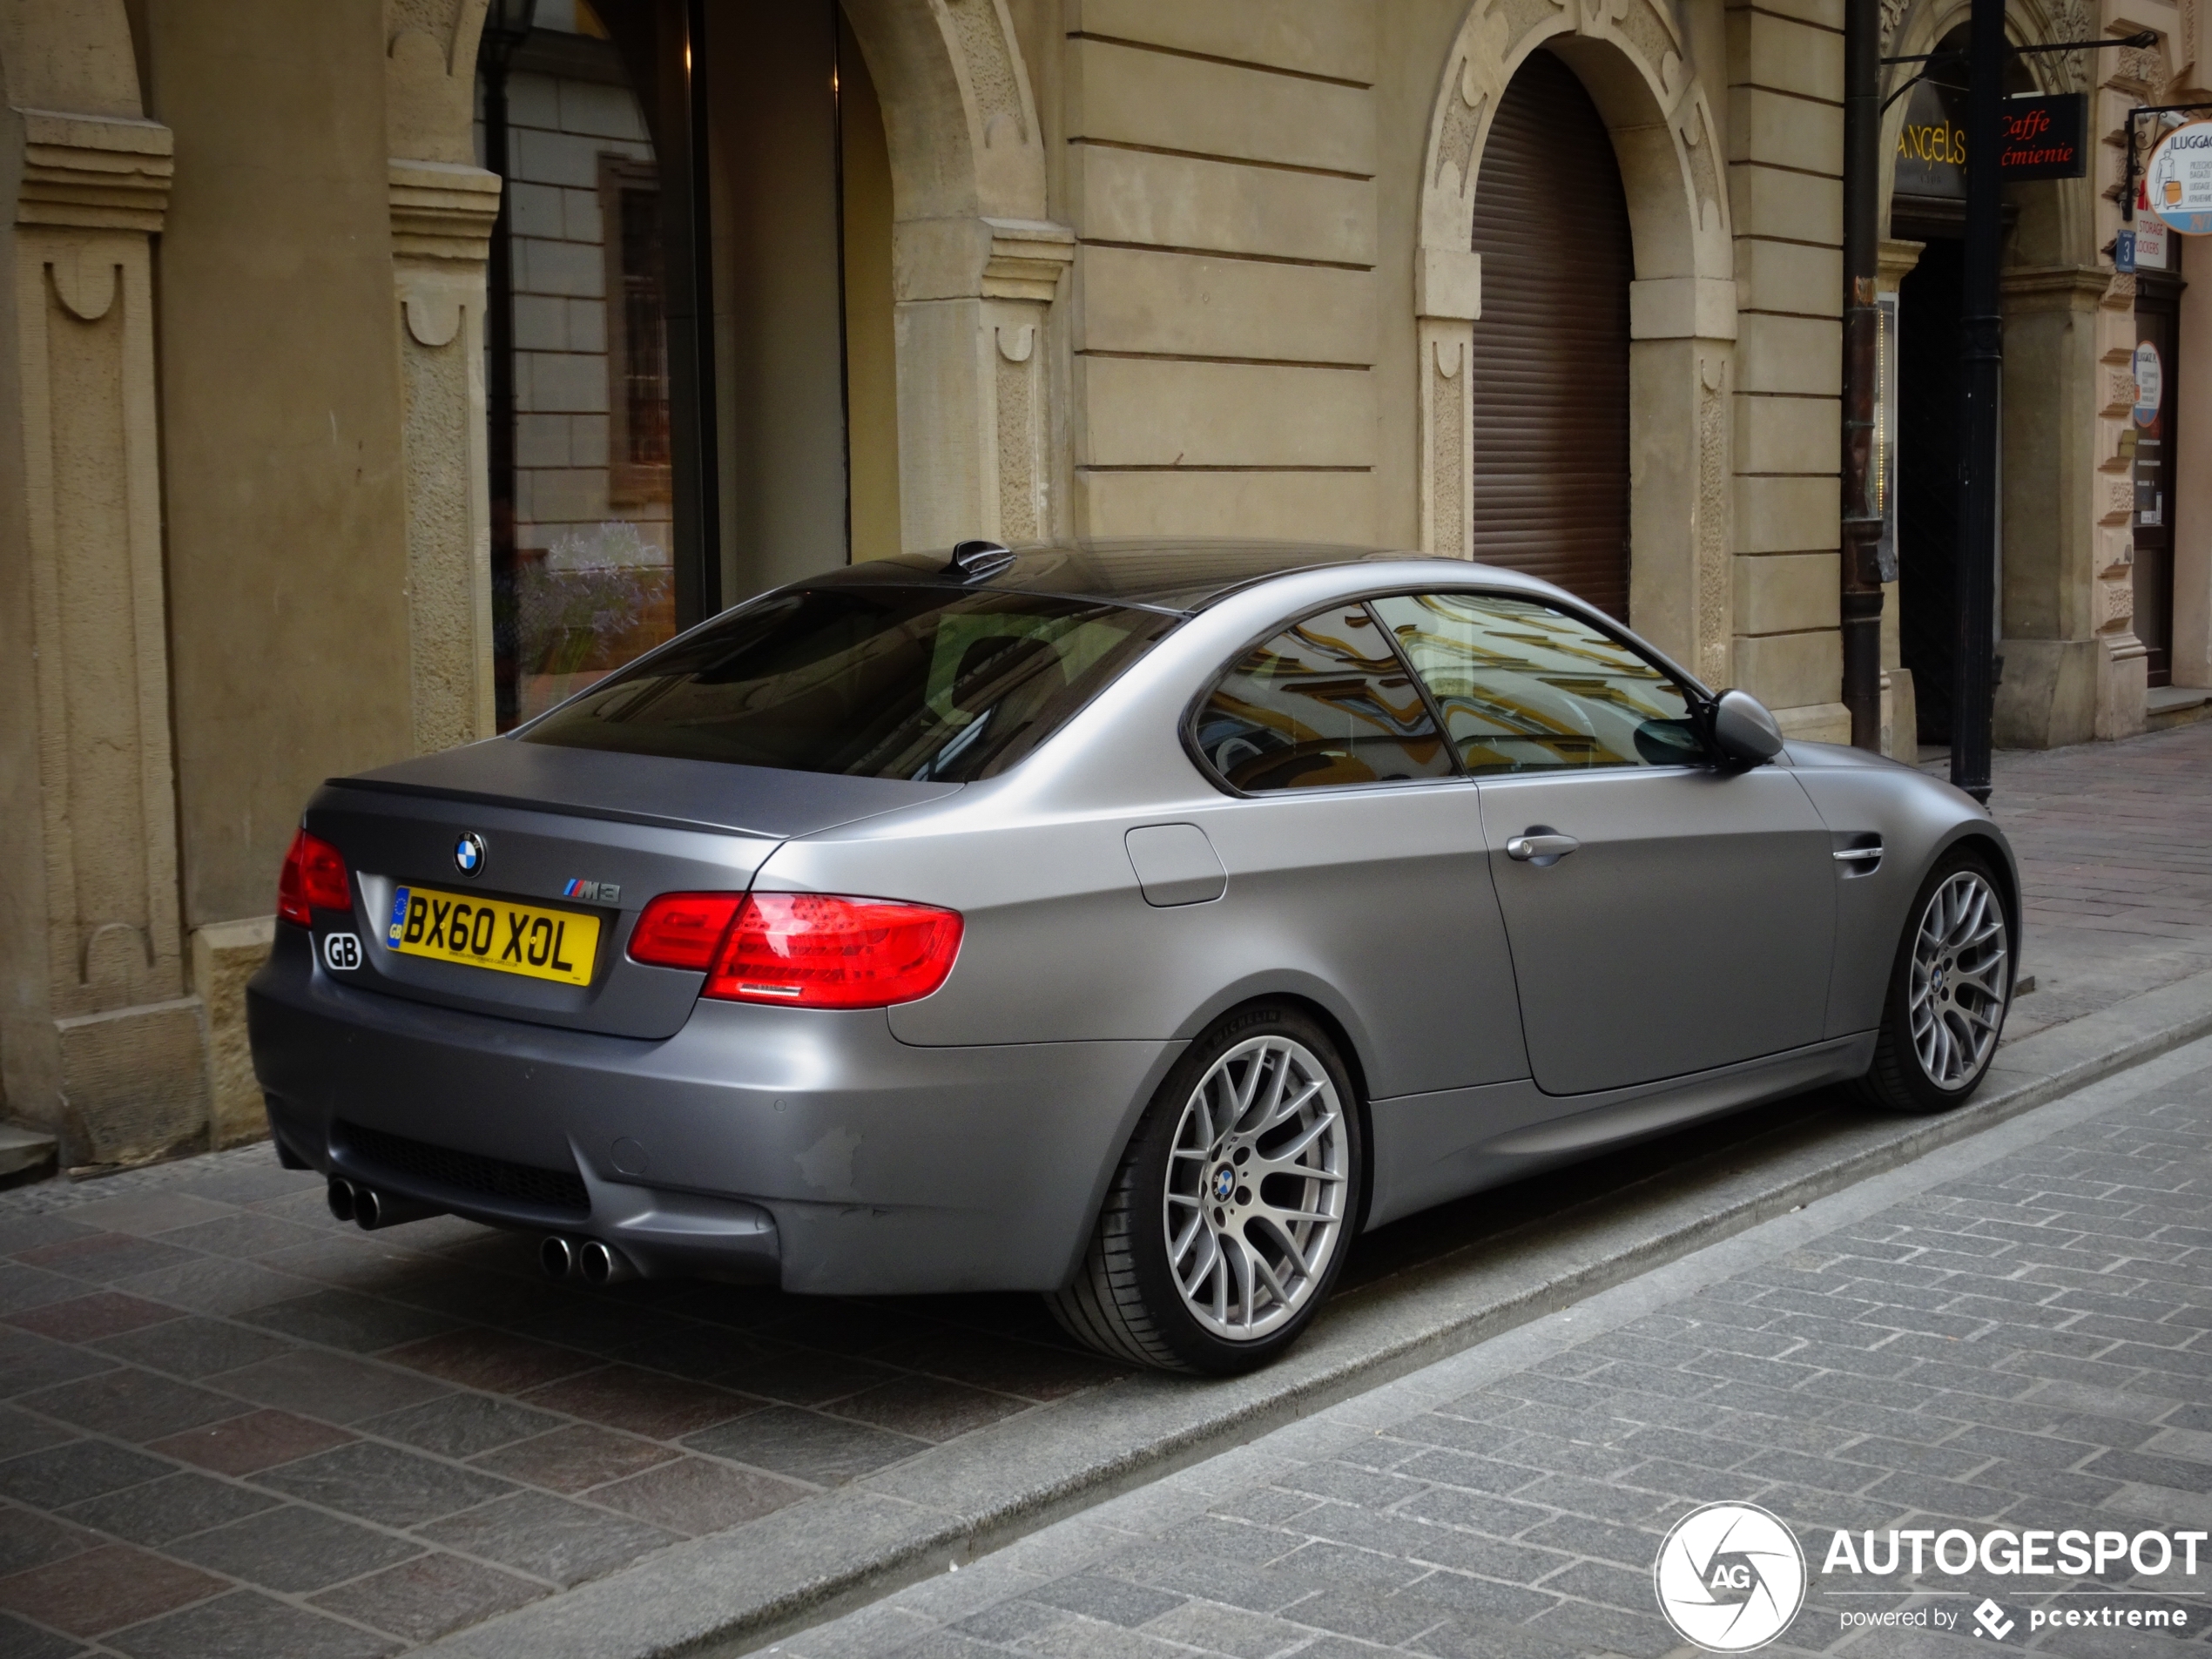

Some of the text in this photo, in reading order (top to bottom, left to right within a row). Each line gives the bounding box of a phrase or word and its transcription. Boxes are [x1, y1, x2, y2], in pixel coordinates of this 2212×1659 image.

[2001, 142, 2074, 166] ćmienie
[2139, 220, 2162, 236] STORAGE
[2123, 240, 2130, 262] 3
[577, 880, 621, 902] M3
[389, 923, 402, 940] GB
[404, 895, 496, 956] BX60
[328, 936, 358, 968] GB
[1213, 1010, 1278, 1046] MICHELIN
